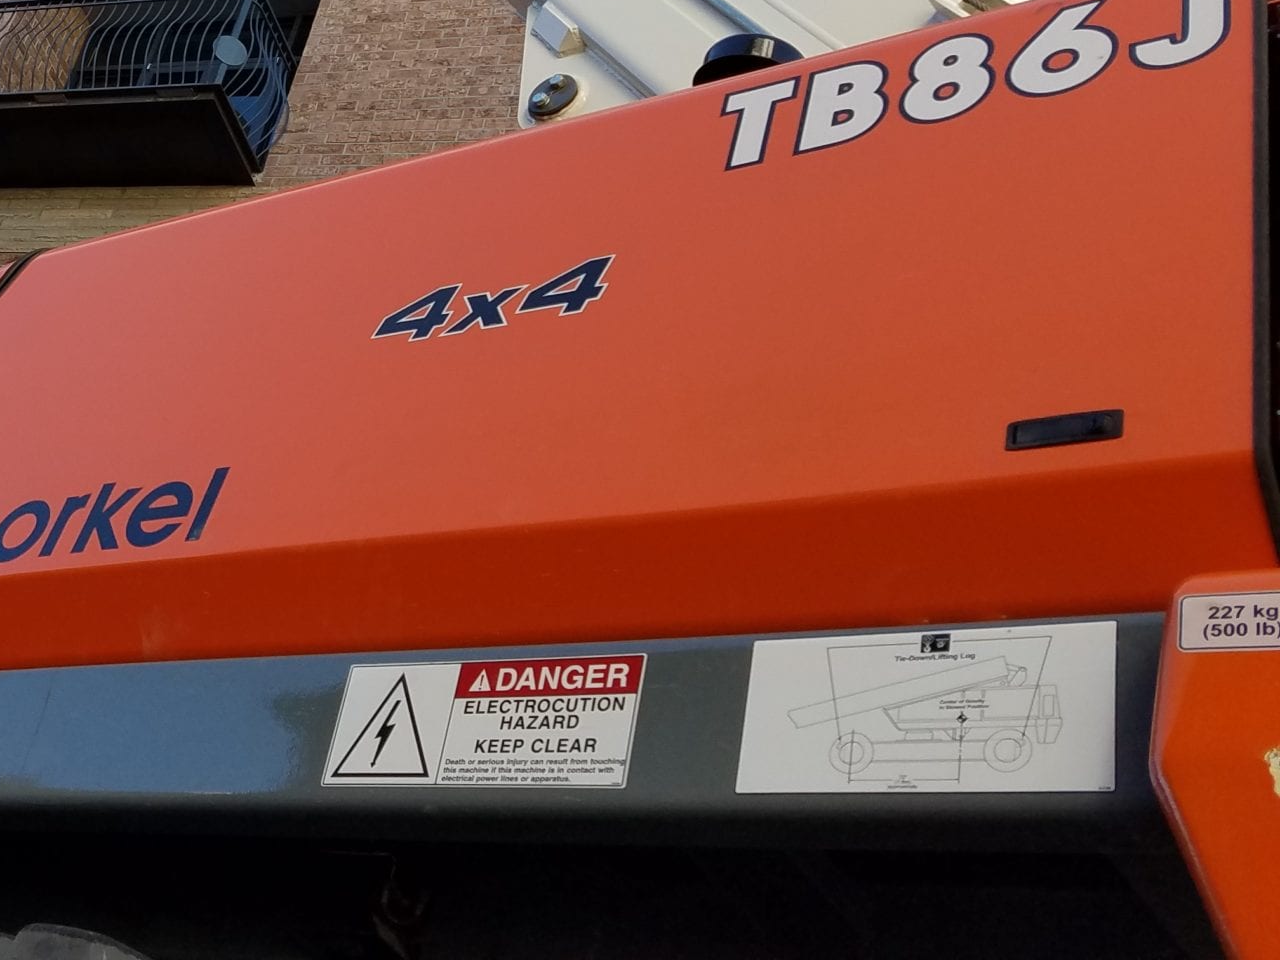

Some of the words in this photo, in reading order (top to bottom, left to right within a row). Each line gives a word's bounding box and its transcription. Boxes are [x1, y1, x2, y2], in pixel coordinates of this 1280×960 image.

[371, 254, 616, 342] 4x4
[1208, 605, 1245, 619] 227
[1253, 604, 1279, 621] kg
[1203, 622, 1248, 641] (500
[1256, 621, 1280, 639] lb)
[496, 663, 630, 691] DANGER
[464, 696, 626, 715] ELECTROCUTION
[500, 715, 580, 730] HAZARD
[474, 739, 524, 754] KEEP
[531, 738, 597, 753] CLEAR
[507, 758, 529, 767] injury
[590, 758, 625, 767] touching
[475, 775, 499, 783] power
[530, 775, 571, 783] apparatus.
